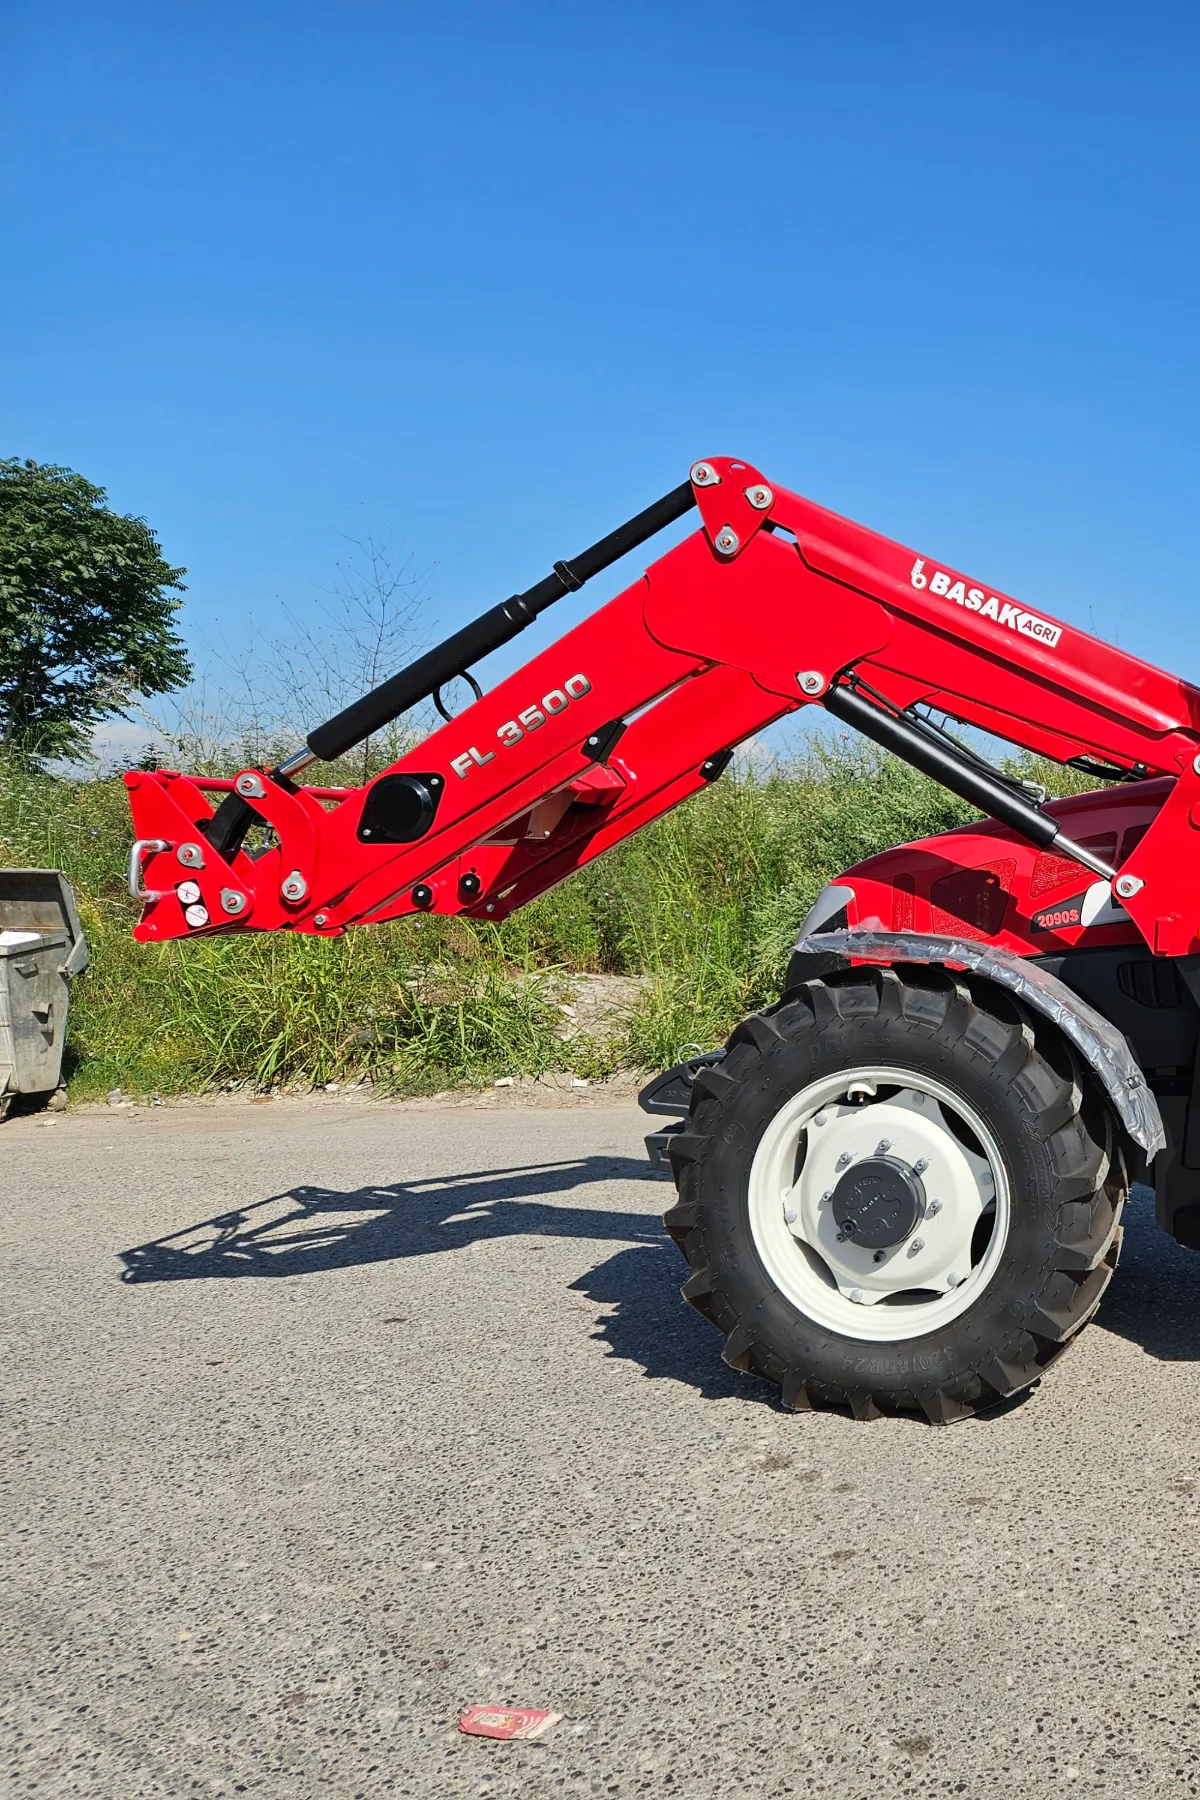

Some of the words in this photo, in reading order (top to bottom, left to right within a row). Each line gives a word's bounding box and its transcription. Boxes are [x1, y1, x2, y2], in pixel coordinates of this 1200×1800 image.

[1022, 618, 1057, 643] AGRI
[449, 745, 497, 781] FL
[496, 672, 593, 748] 3500
[1037, 908, 1080, 928] 2090S
[841, 1346, 957, 1376] 320/85R24
